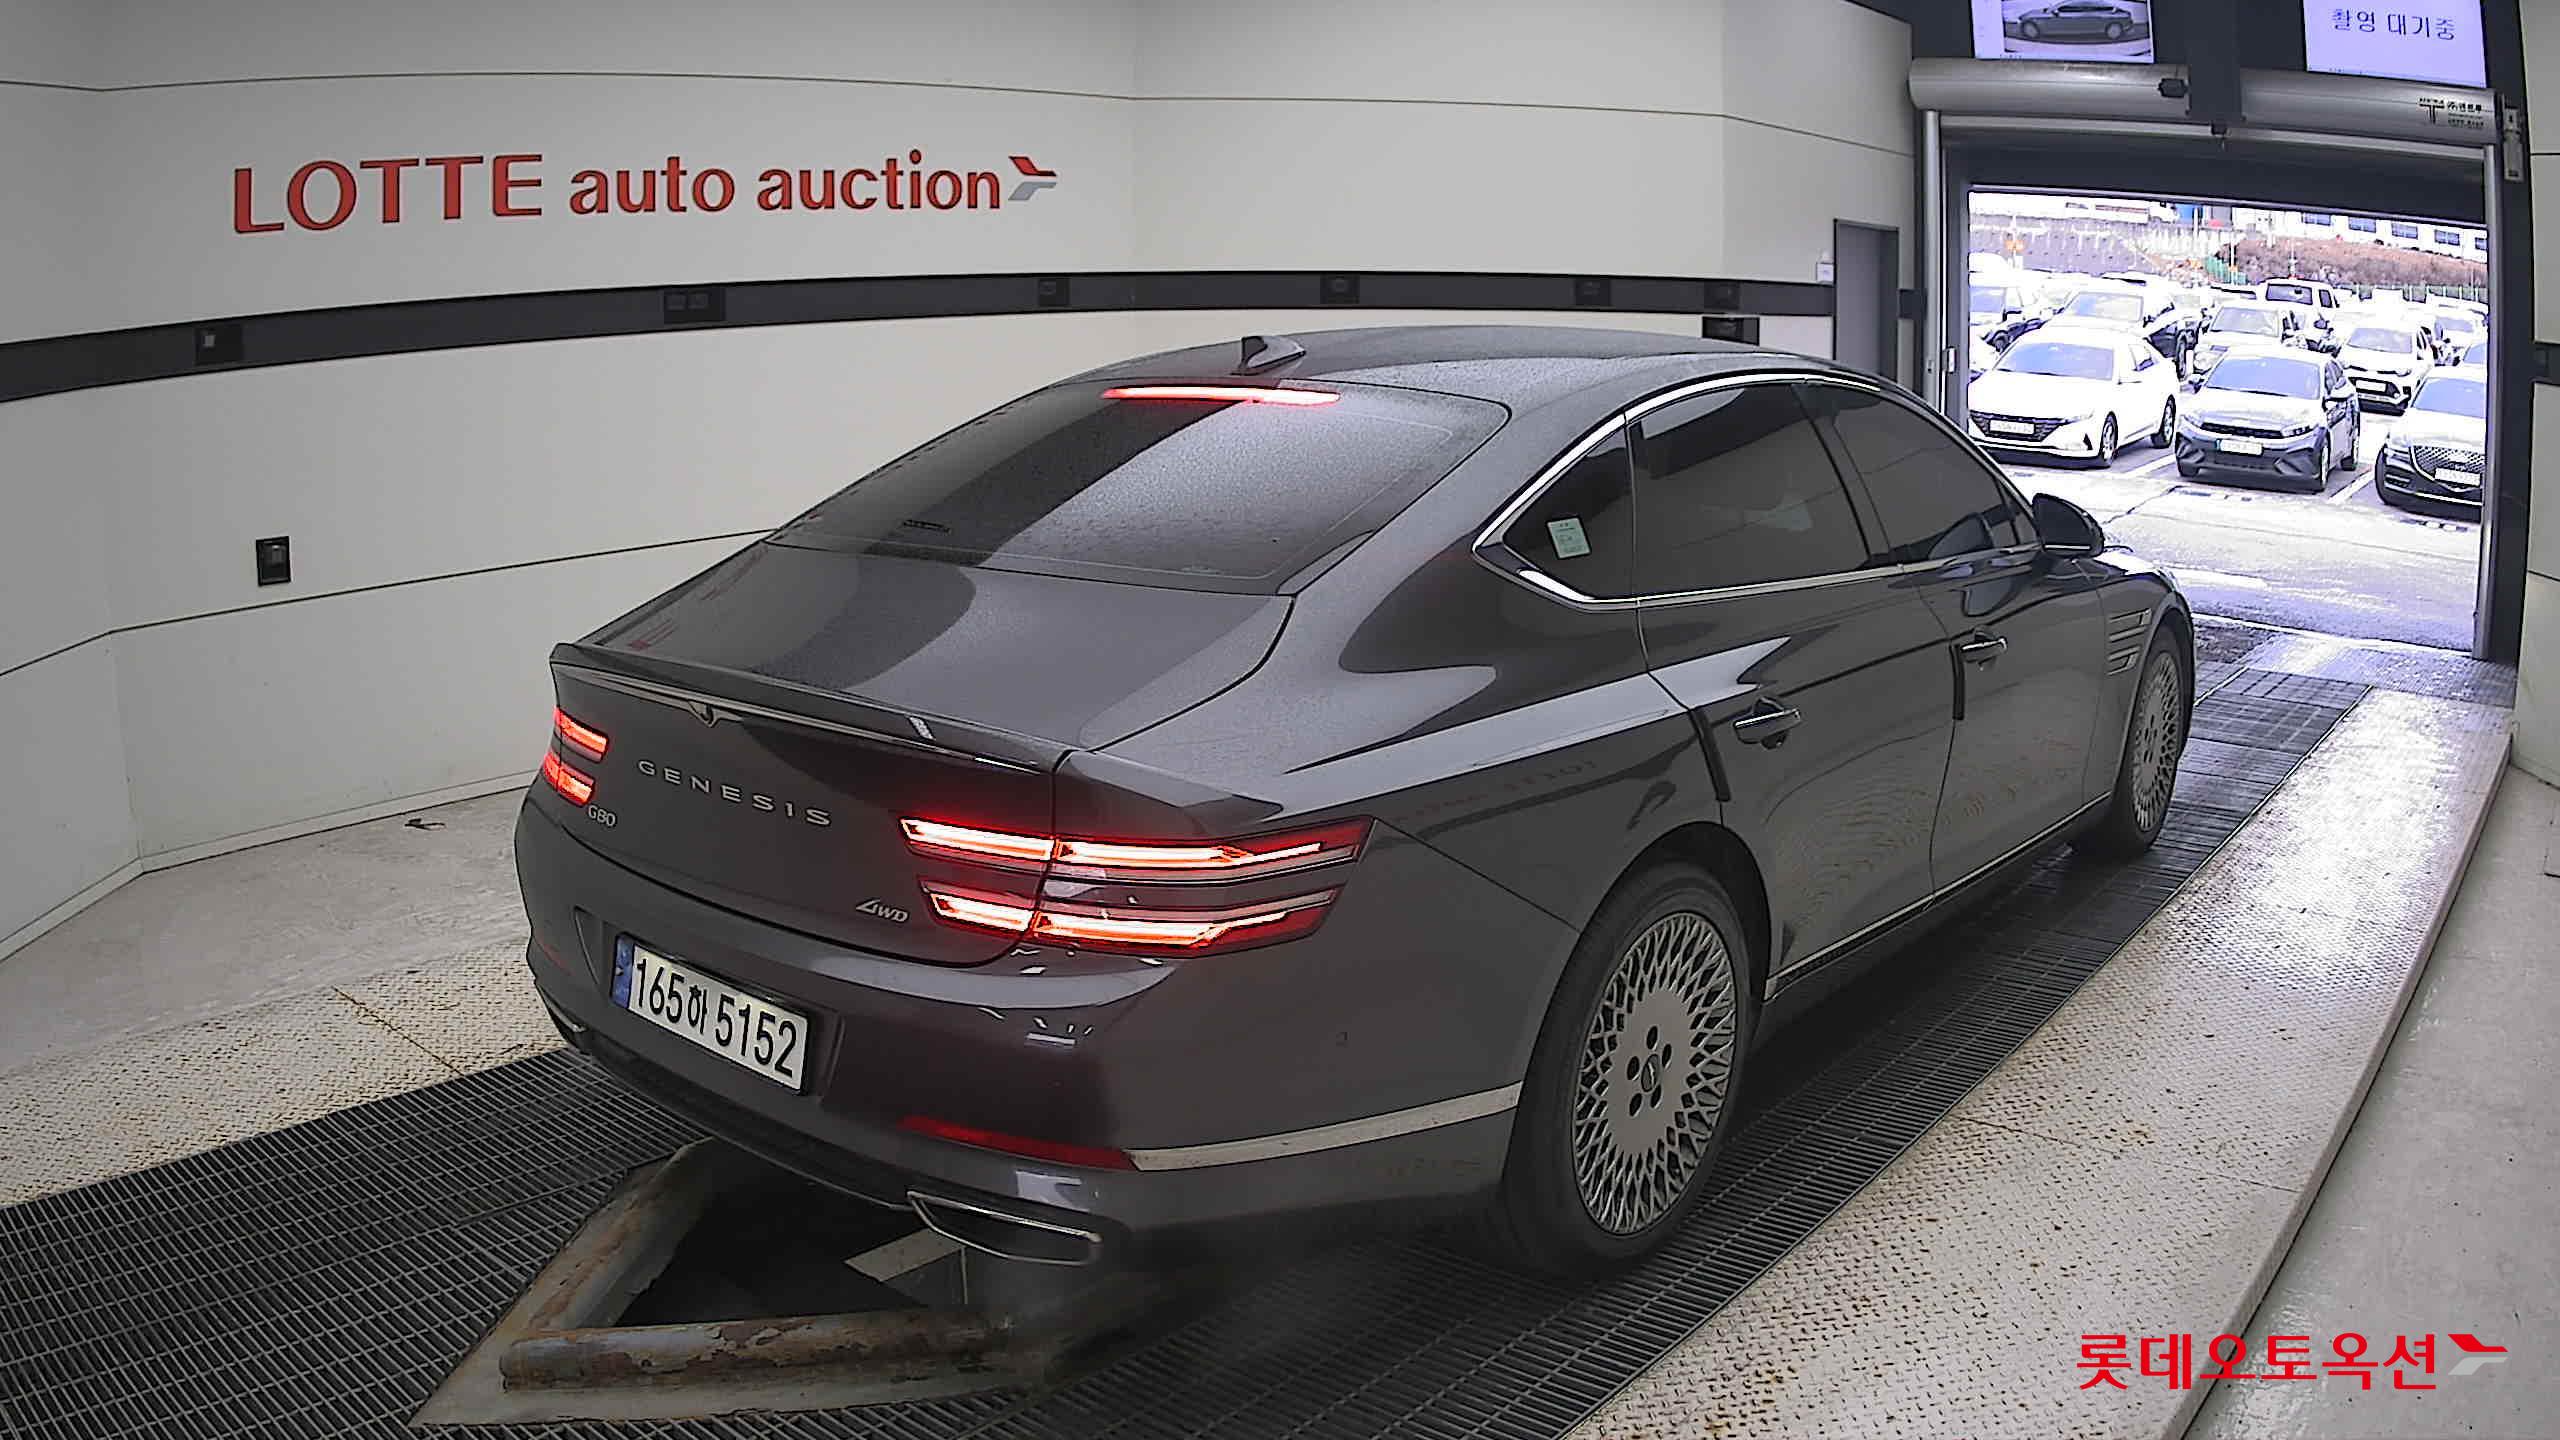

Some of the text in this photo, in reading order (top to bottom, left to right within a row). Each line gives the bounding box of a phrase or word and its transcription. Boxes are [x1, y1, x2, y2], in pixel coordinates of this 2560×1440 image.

[2387, 13, 2456, 41] 대기중
[234, 149, 1002, 235] LOTTE auto auction
[587, 804, 617, 828] G80
[637, 760, 831, 827] GENESIS
[856, 899, 909, 923] 4WD
[636, 958, 708, 1035] 165하
[715, 992, 797, 1078] 5152
